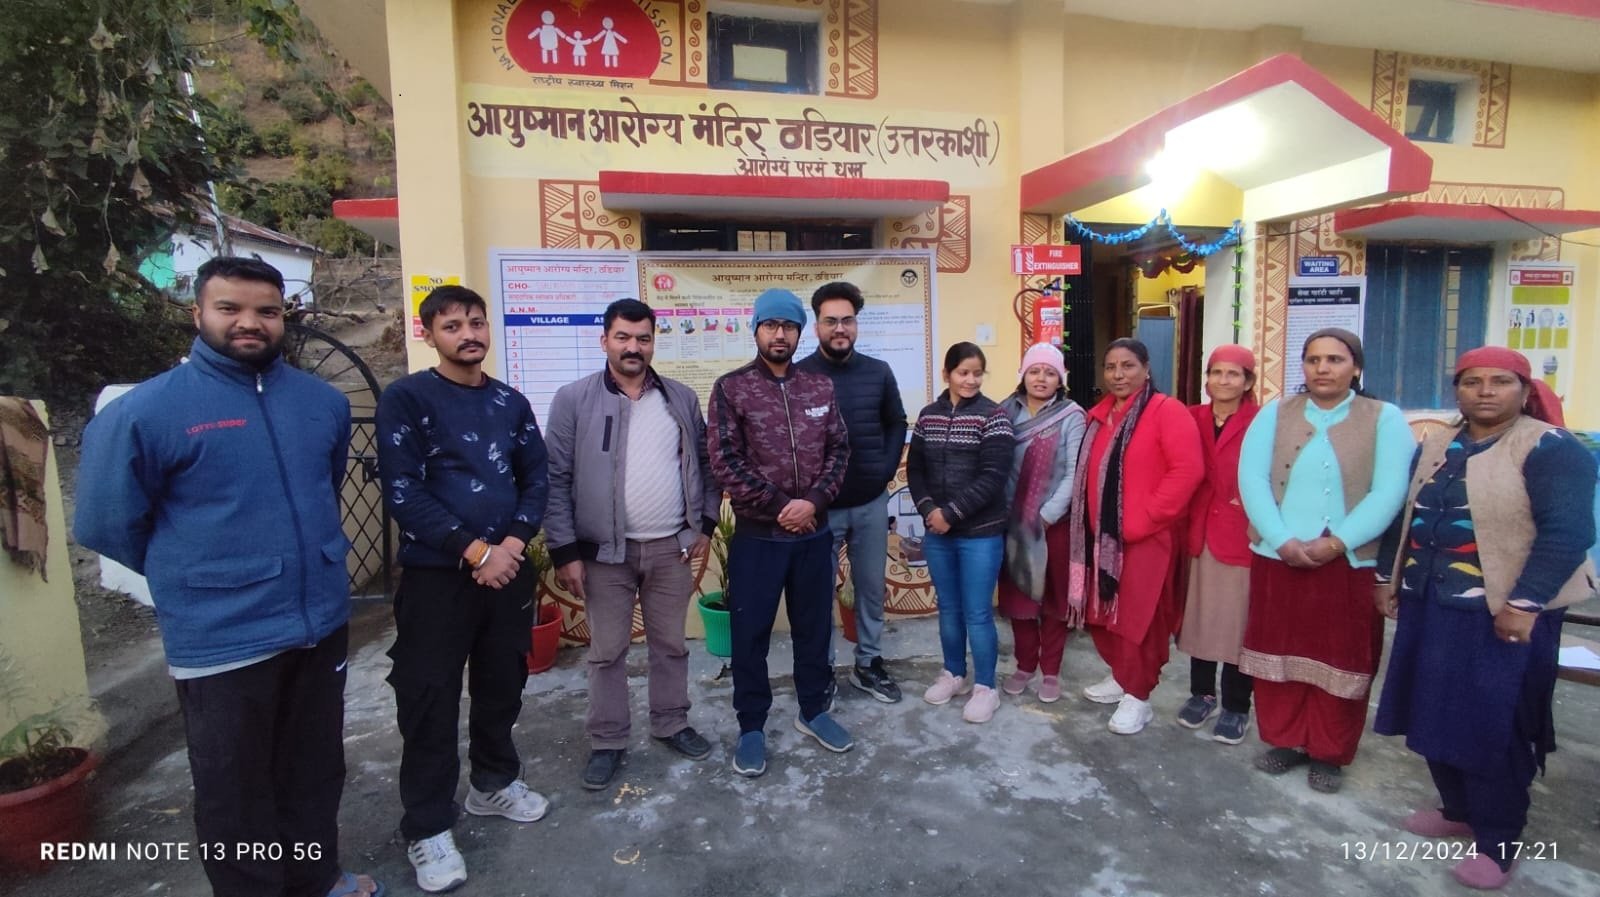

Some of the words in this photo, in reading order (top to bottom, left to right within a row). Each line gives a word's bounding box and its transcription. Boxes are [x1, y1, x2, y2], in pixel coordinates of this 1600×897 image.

[467, 101, 587, 149] आयुष्मान
[588, 96, 685, 148] आरोग्य
[688, 102, 770, 156] मंदिर
[775, 107, 878, 156] ठडियार
[877, 115, 1001, 168] (उत्तरकाशी)
[1049, 249, 1063, 258] FIRE
[1034, 262, 1079, 270] EXTINGUISHER
[530, 316, 569, 324] VILLAGE
